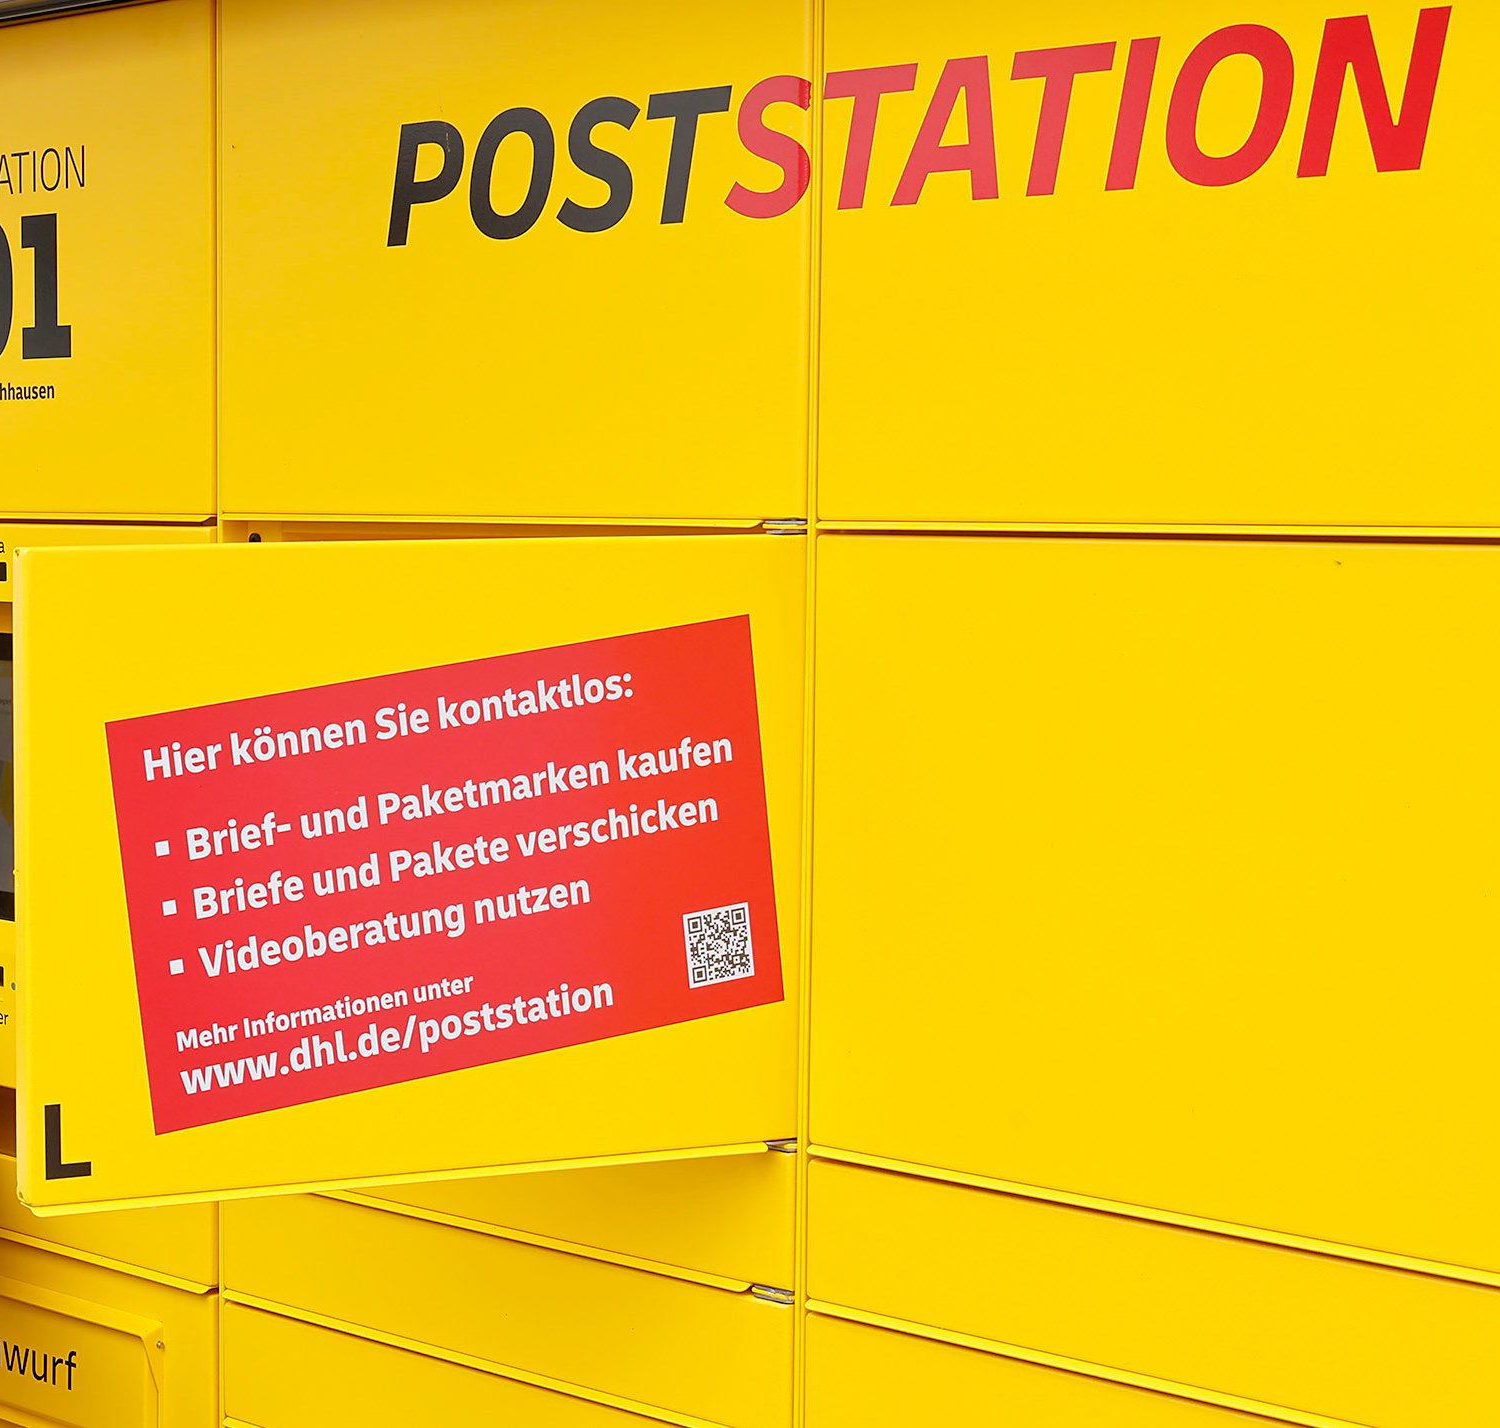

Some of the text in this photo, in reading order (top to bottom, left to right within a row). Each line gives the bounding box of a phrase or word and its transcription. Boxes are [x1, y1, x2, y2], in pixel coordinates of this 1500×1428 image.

[386, 4, 1453, 248] POSTSTATION
[143, 672, 634, 782] Hier können Sie kontaktlos:
[186, 735, 733, 861] Brief- und Paketmarken kaufen
[193, 796, 719, 920] Briefe und Pakete verschicken
[197, 879, 591, 978] Videoberatung nutzen
[176, 975, 474, 1052] Mehr Informationen unter
[179, 982, 614, 1095] www.dhl.de/poststation
[44, 1104, 92, 1180] L
